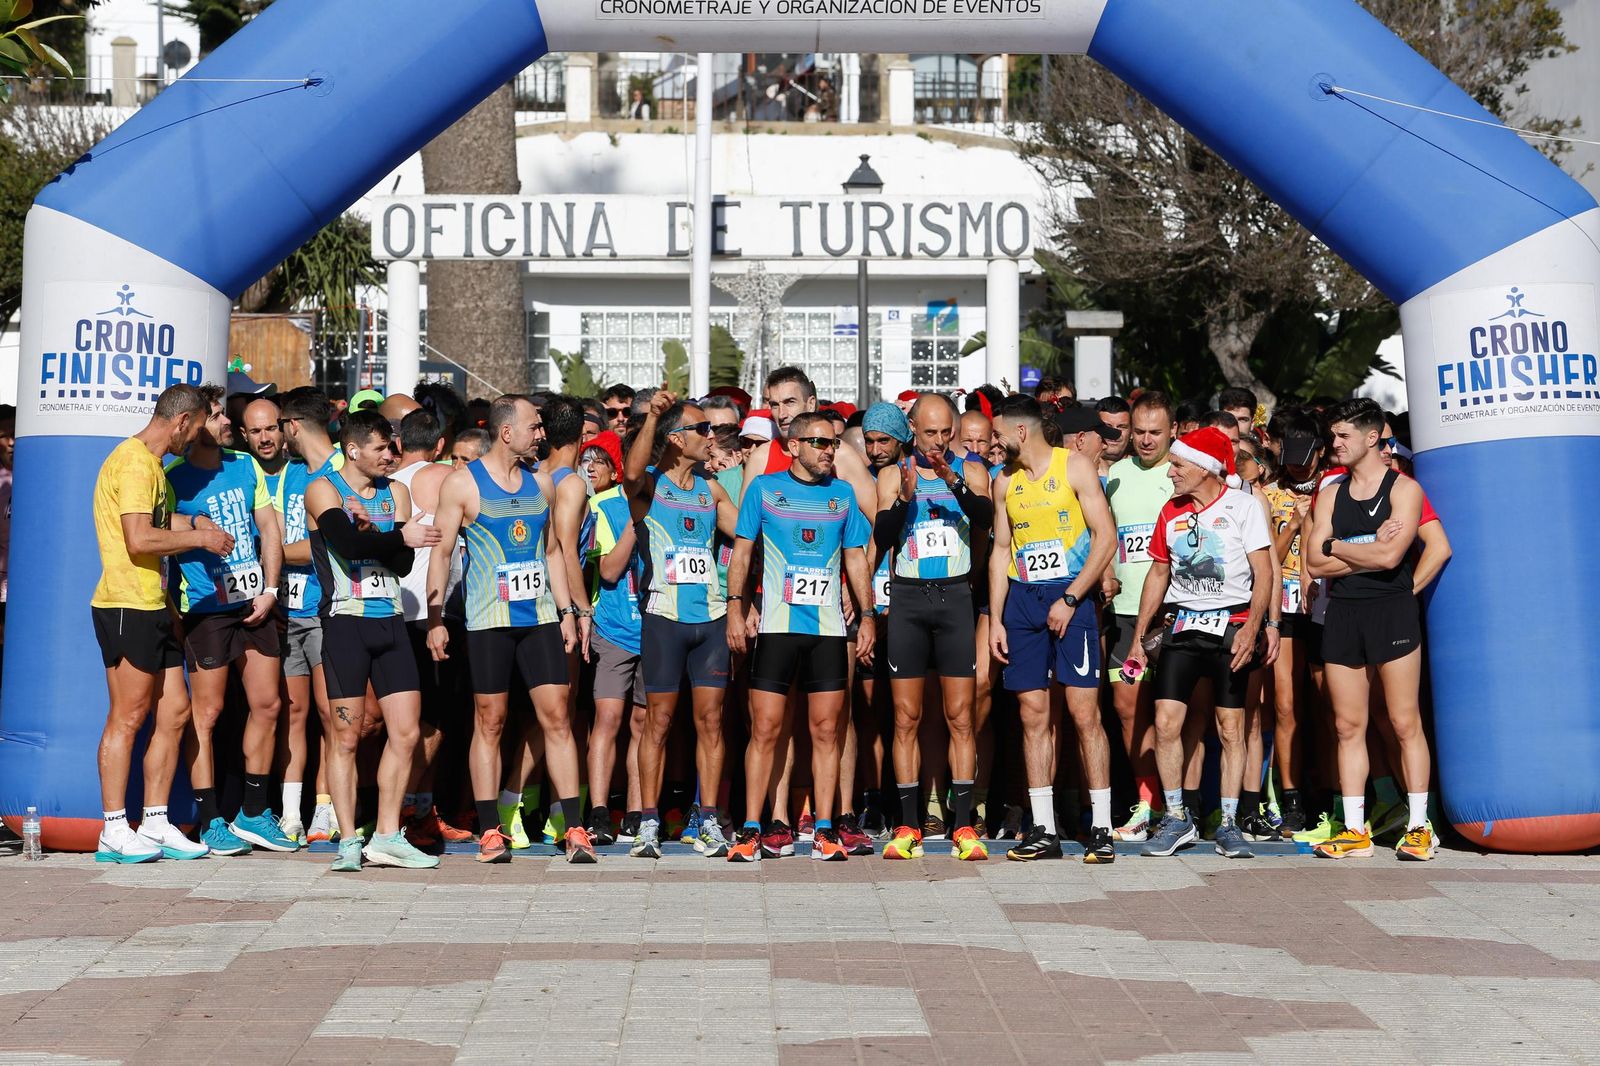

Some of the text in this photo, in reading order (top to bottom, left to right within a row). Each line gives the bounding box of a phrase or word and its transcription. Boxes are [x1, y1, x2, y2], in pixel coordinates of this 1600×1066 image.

[600, 0, 752, 14] CRONOMETRAJE
[760, 0, 772, 14] Y
[923, 0, 947, 14] DE
[953, 0, 1041, 13] EVENTOS
[382, 201, 1030, 257] OFICINA DE TURISMO
[75, 319, 175, 356] CRONO
[1470, 320, 1569, 358] CRONO
[1438, 353, 1600, 410] FINISHER
[39, 403, 156, 415] CRONOMETRAJE Y ORGANIZACIÓ
[1441, 403, 1600, 423] CRONOMETRAJE Y ORGANIZACIÓN DE EVENTO
[219, 487, 246, 506] SAN
[222, 501, 250, 525] SIL
[926, 531, 947, 548] 81
[679, 558, 706, 575] 103
[1027, 552, 1061, 572] 232
[227, 572, 258, 594] 219
[371, 571, 386, 588] 31
[511, 572, 541, 592] 115
[795, 578, 830, 597] 217
